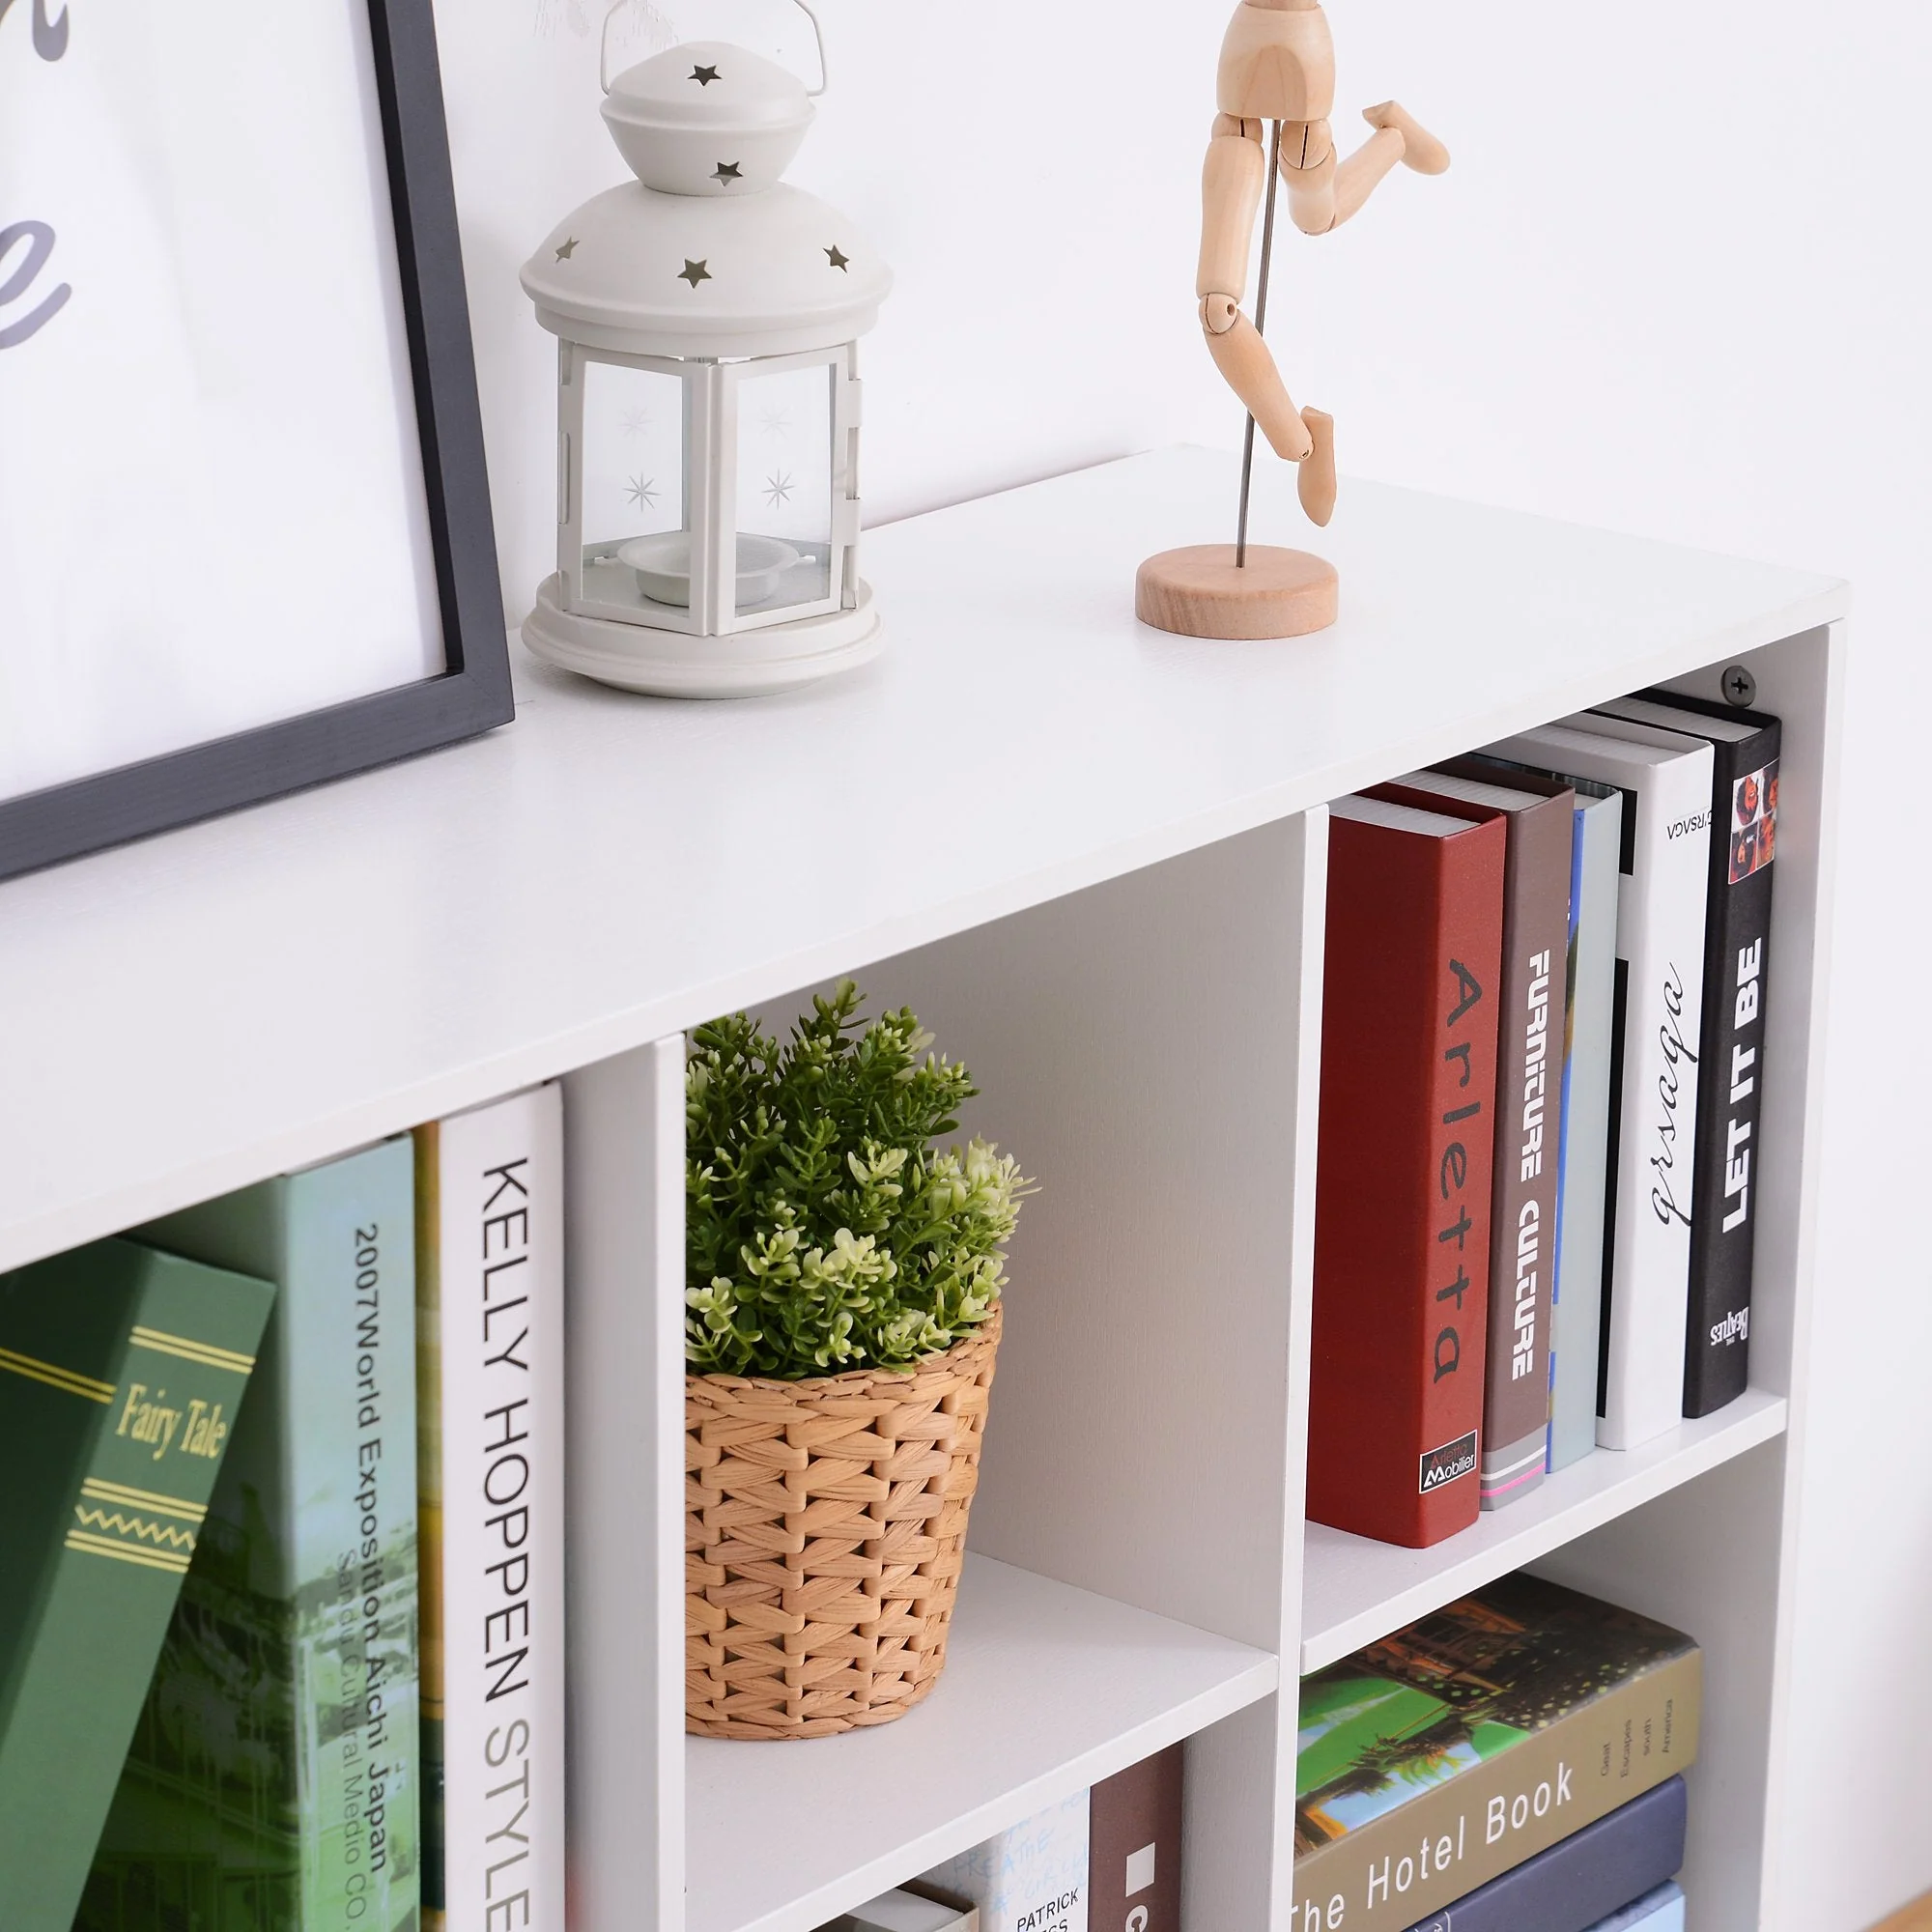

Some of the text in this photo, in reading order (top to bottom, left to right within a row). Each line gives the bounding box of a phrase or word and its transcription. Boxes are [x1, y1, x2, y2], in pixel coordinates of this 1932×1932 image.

[1722, 938, 1761, 1234] LET IT BE
[1434, 958, 1482, 1383] Arletta
[1512, 1200, 1540, 1381] CULTURE
[1710, 1306, 1749, 1346] BEATLES
[115, 1383, 228, 1461] Fairy Tale
[1423, 1454, 1474, 1488] Mobilier
[354, 1223, 388, 1873] 2007World Exposition Aichi Japan
[483, 1157, 529, 1932] KELLY HOPPEN STYLE
[340, 1653, 364, 1771] Cultural
[1016, 1888, 1079, 1932] PATRICK
[1367, 1815, 1465, 1910] Hotel
[1486, 1762, 1573, 1844] Book
